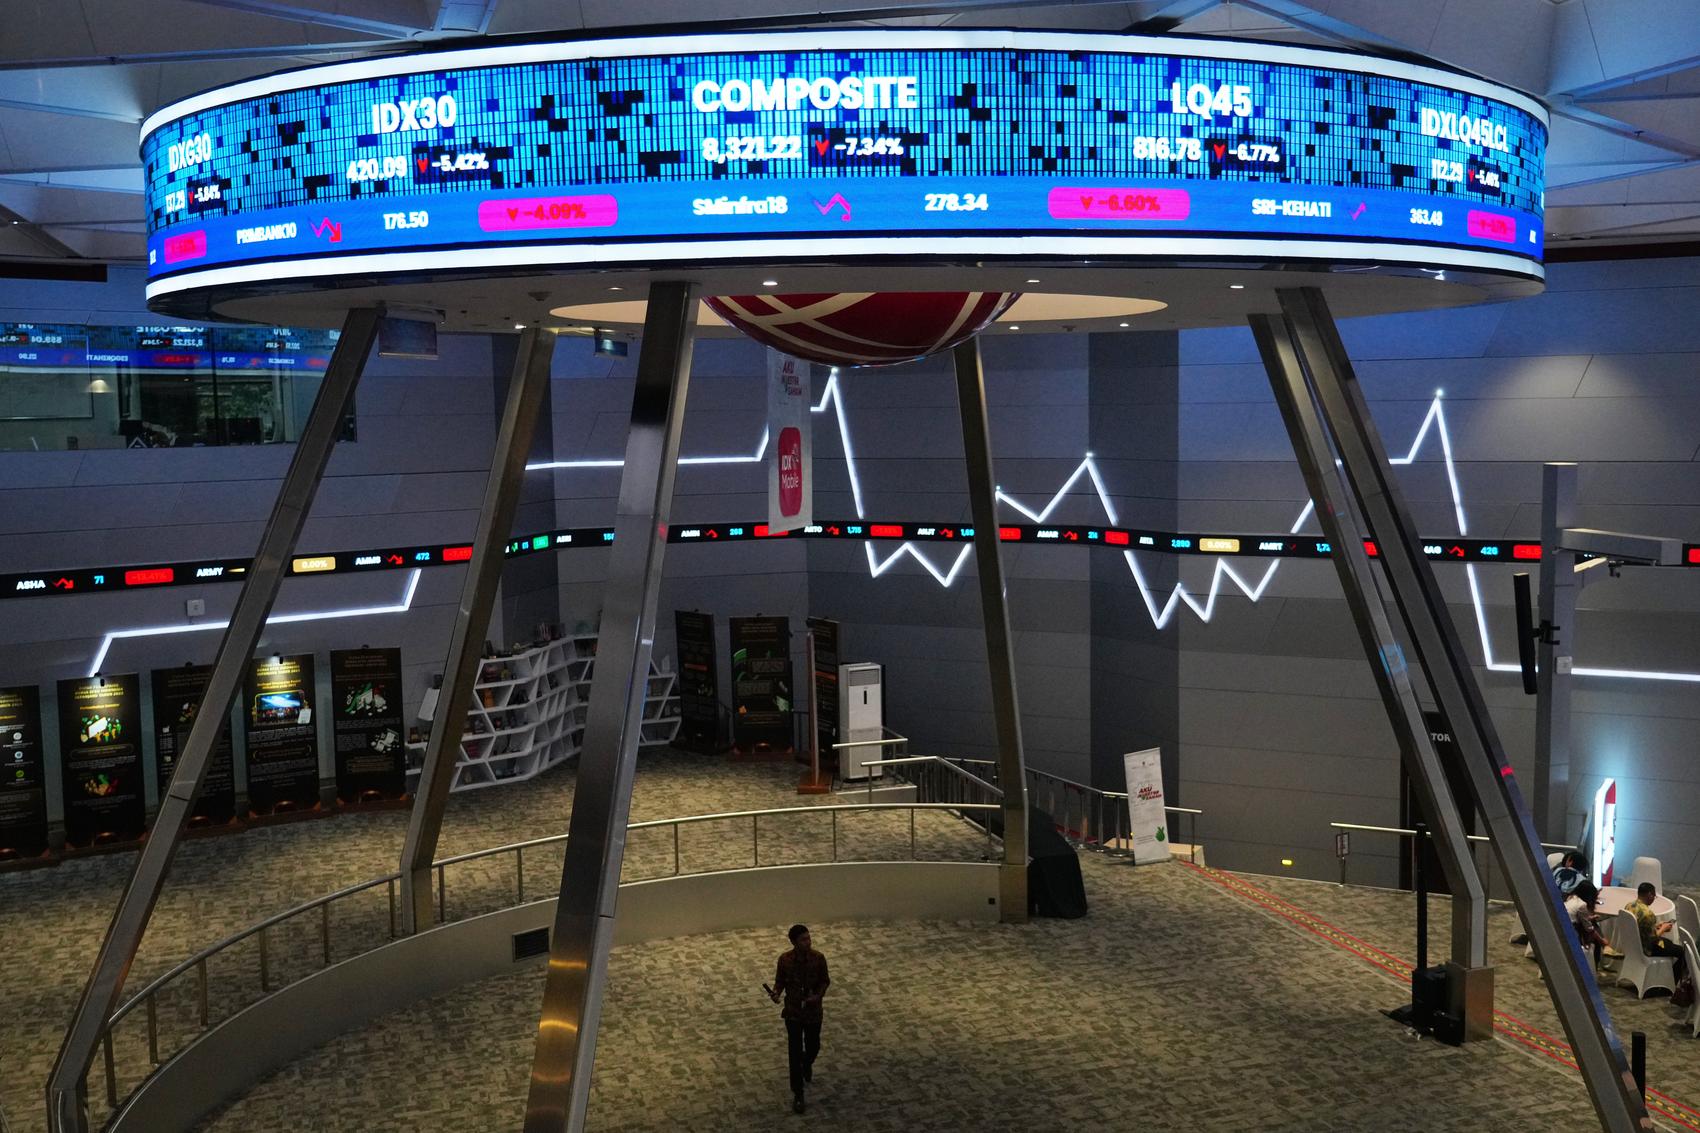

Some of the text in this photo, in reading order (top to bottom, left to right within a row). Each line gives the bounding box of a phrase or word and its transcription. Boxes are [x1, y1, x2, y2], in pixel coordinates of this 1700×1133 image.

[692, 76, 917, 112] COMPOSITE
[1172, 82, 1252, 120] LQ45
[372, 95, 457, 134] IDX30
[1421, 107, 1508, 152] IDXLQ45LCL
[169, 133, 211, 172] IDXG30
[346, 152, 489, 181] 420.09 -5.42%
[702, 136, 904, 163] 8,321.22 -7.34%
[1133, 136, 1280, 162] 816.78 -6.77%
[383, 211, 429, 229] 176.50
[524, 203, 586, 221] -4.09%
[924, 193, 988, 211] 278.34
[1252, 199, 1331, 217] SRI-KEHATI
[782, 474, 799, 488] Mobile
[16, 579, 46, 590] ASHA
[94, 575, 104, 584] 71
[196, 567, 223, 578] ARMY
[302, 559, 327, 569] 0.00%
[415, 552, 430, 561] 472
